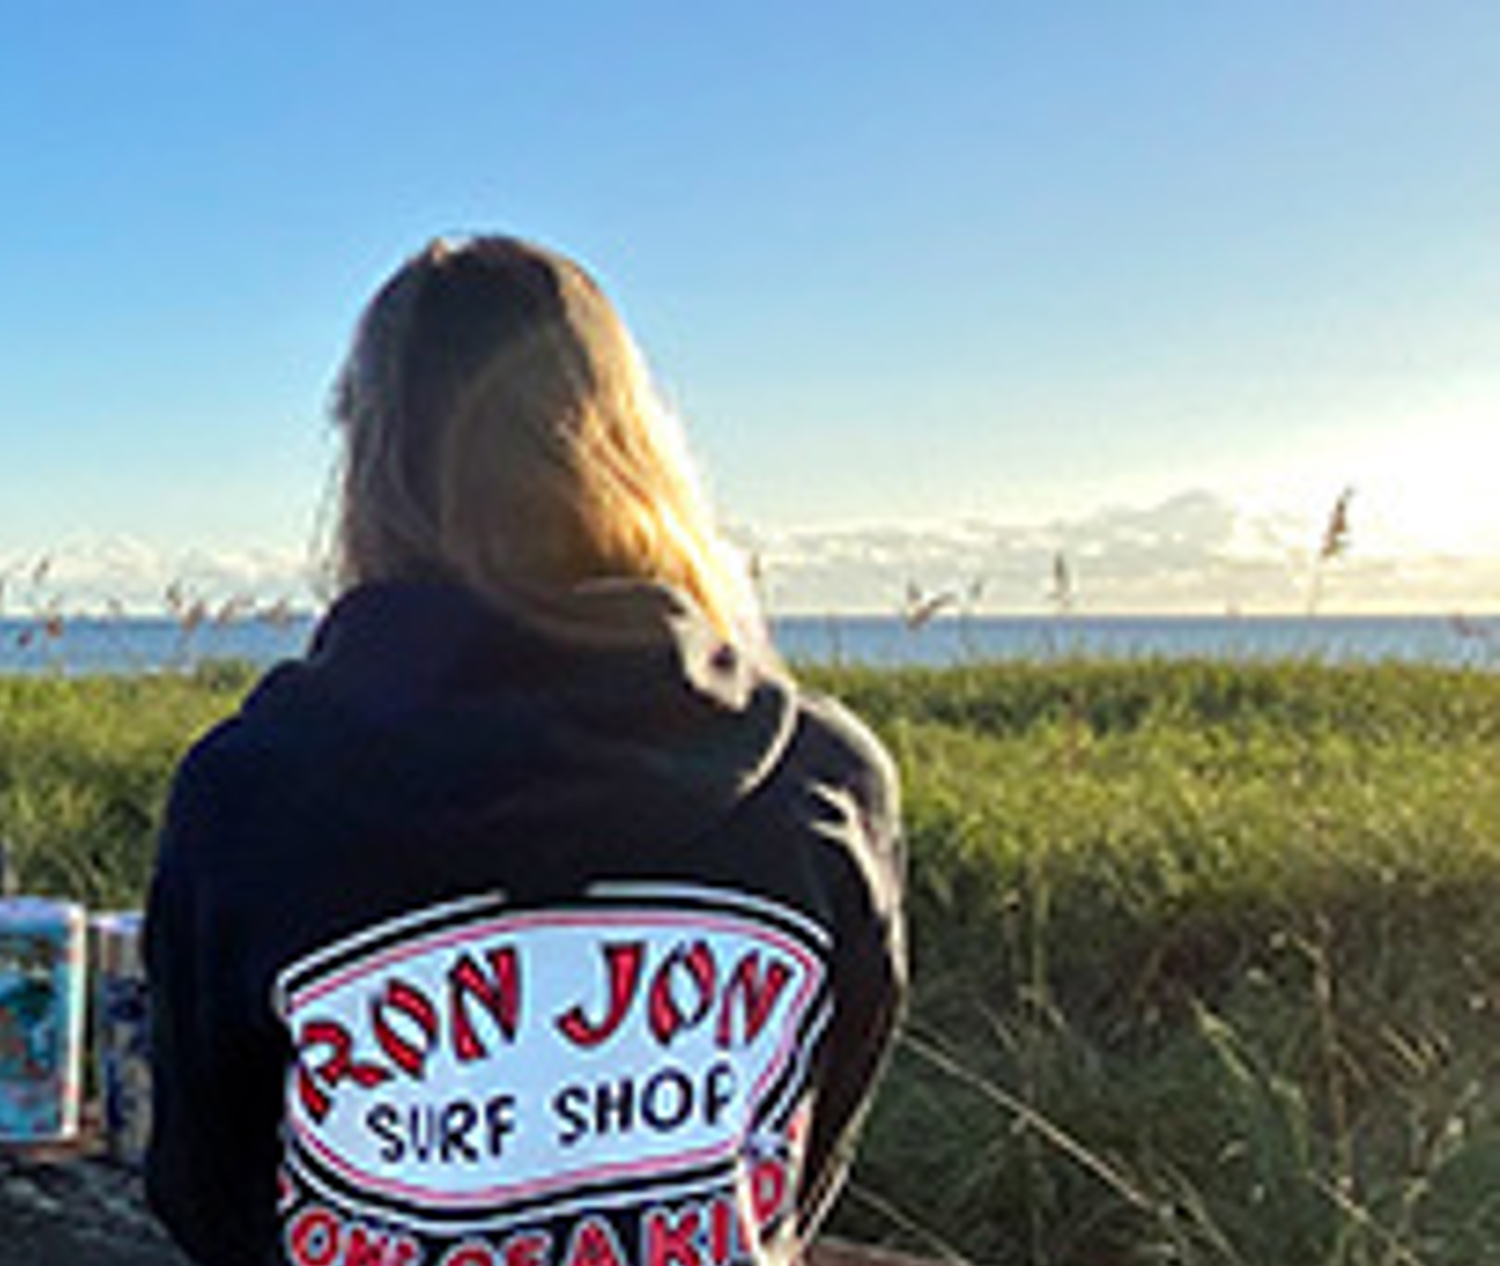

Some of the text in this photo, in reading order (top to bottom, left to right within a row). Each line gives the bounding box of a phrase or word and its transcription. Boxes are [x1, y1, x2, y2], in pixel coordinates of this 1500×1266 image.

[297, 939, 796, 1124] RON JON
[365, 1060, 736, 1164] SURF SHOP
